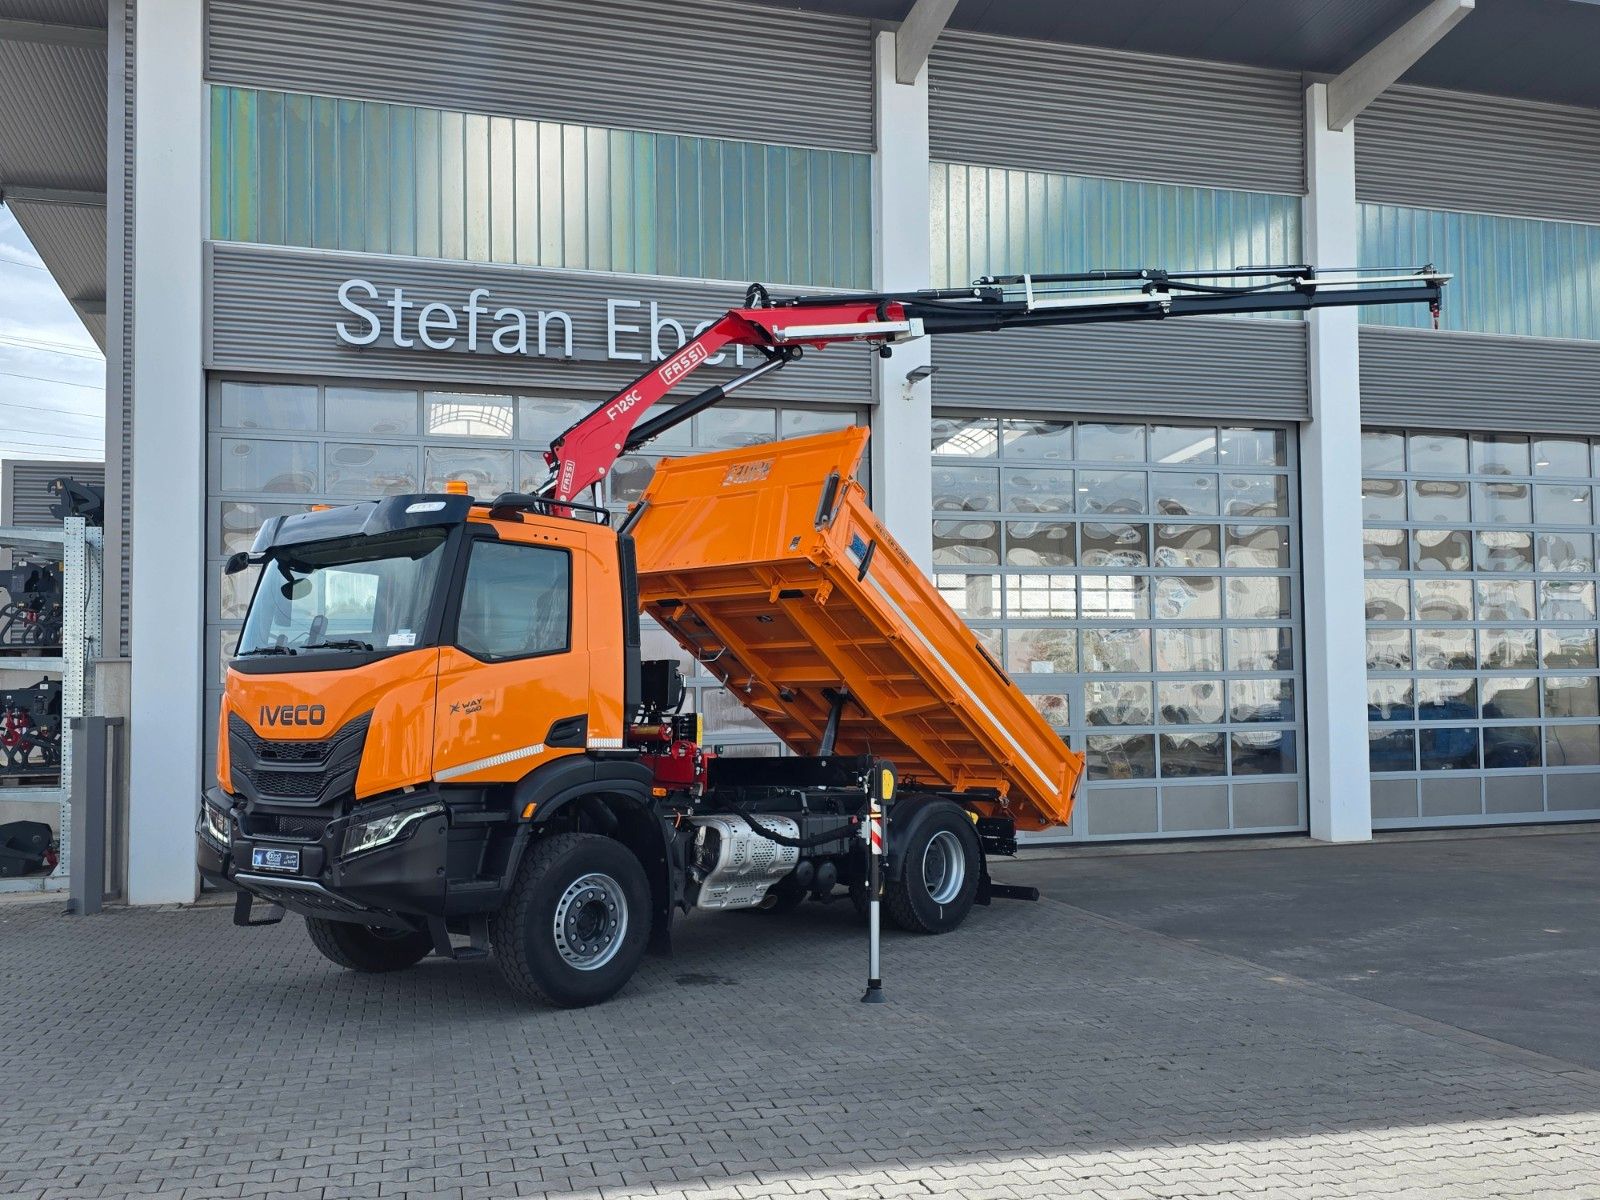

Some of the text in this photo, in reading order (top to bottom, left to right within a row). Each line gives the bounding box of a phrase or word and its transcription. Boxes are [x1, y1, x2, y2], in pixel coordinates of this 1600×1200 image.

[336, 279, 573, 358] Stefan
[664, 346, 704, 380] FASSI
[606, 389, 642, 421] F125C
[562, 462, 574, 490] FASSI
[259, 704, 326, 727] IVECO
